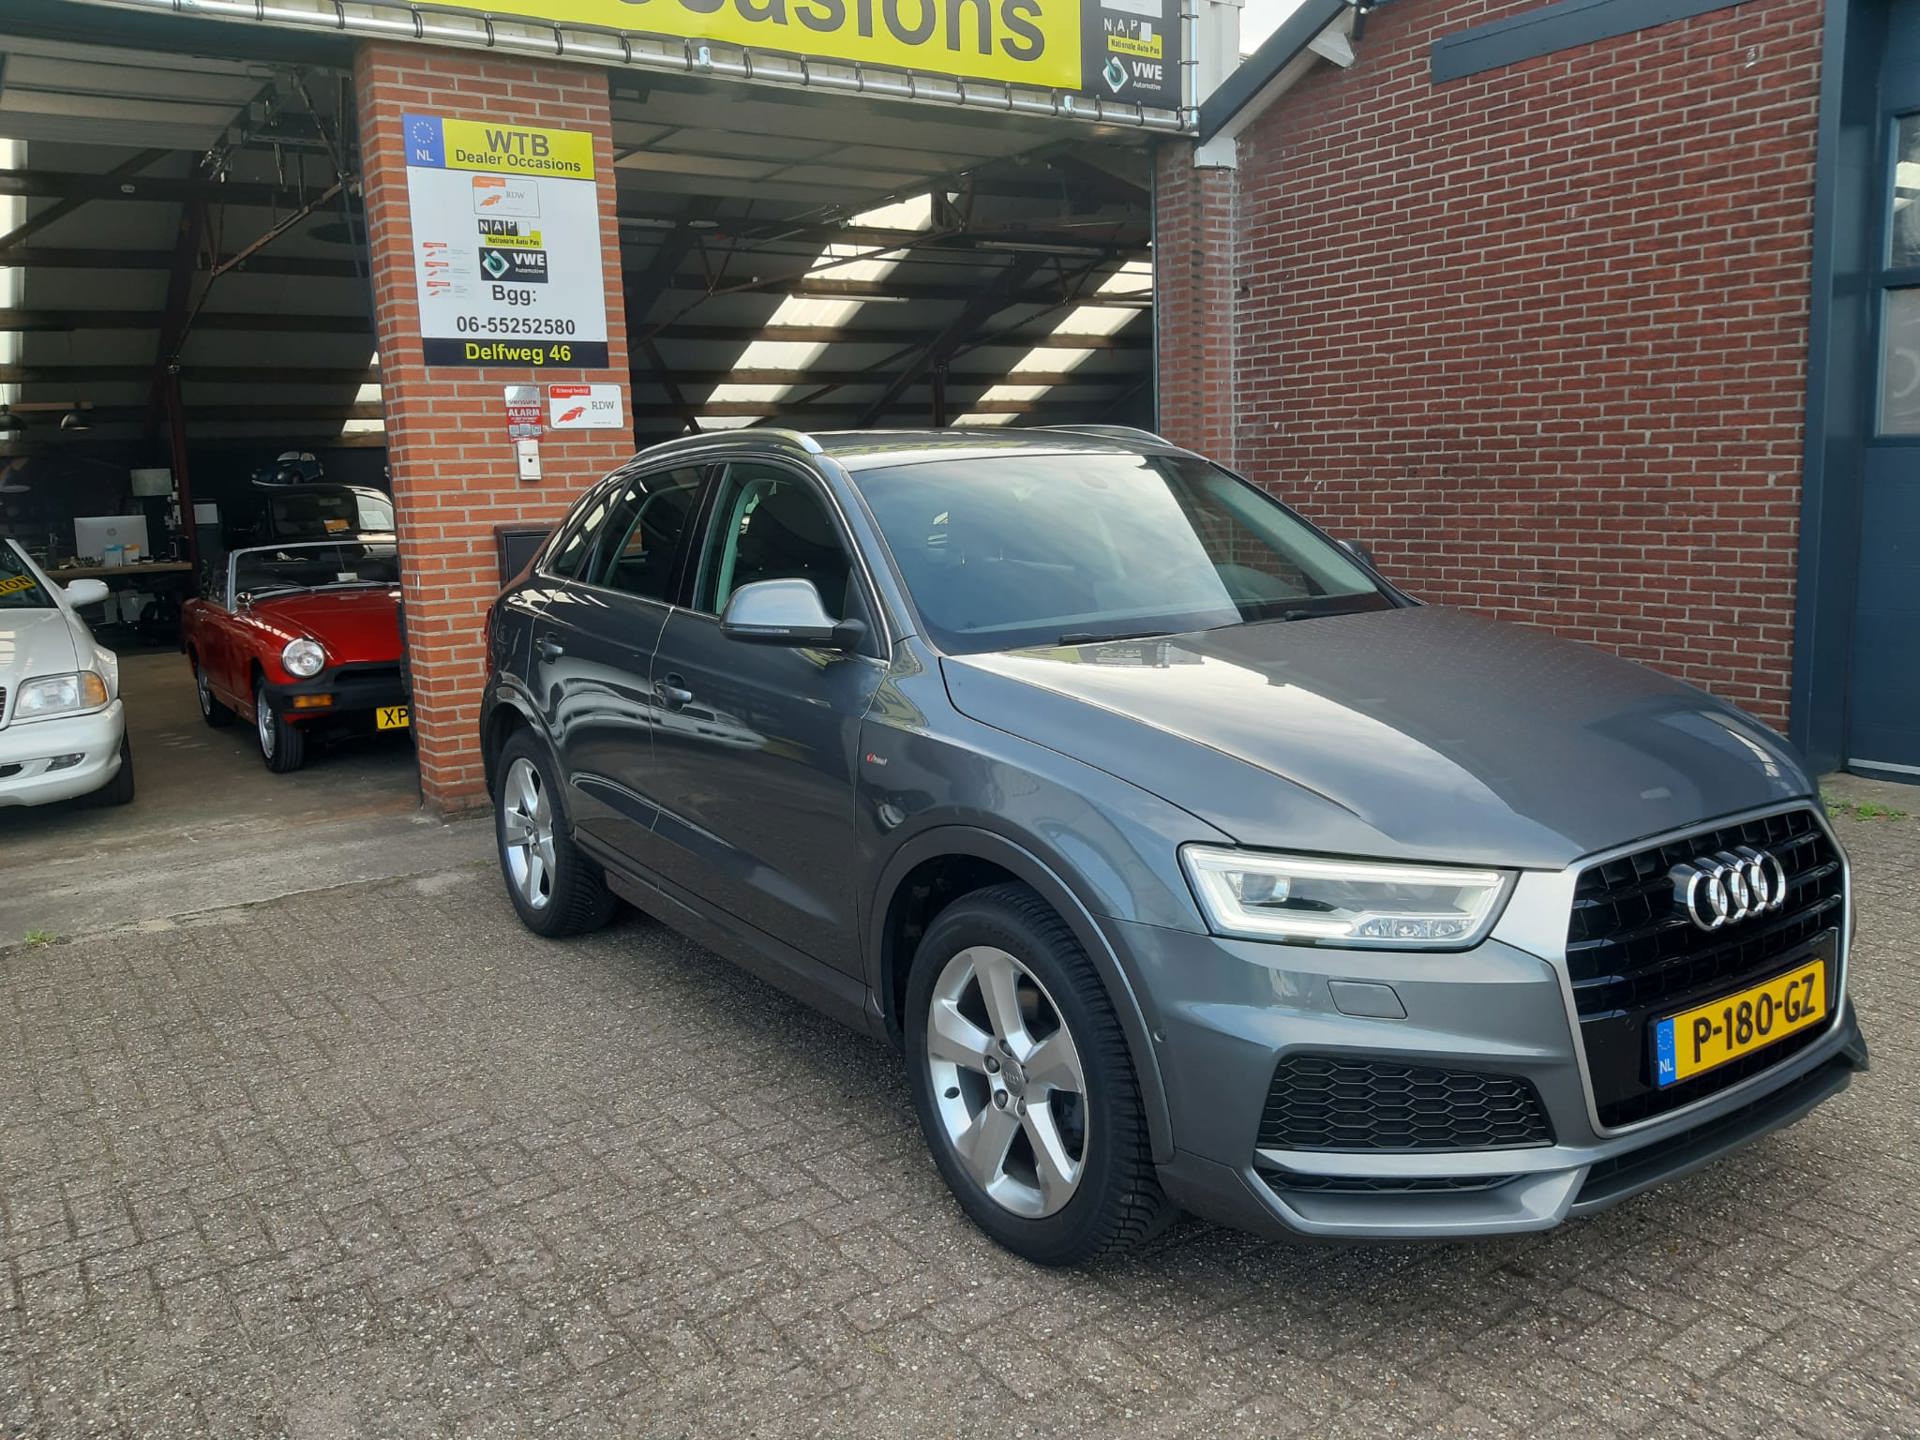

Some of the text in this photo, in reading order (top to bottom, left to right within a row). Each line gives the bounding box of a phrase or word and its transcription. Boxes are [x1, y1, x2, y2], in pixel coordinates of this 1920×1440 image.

[1112, 39, 1160, 54] Nationale Auto Pas
[1132, 61, 1163, 80] VWE
[1133, 81, 1161, 90] Automotive
[485, 128, 549, 157] WTB
[416, 149, 434, 161] NL
[456, 149, 581, 172] Dealer Occasions
[506, 191, 525, 199] RDW
[488, 237, 514, 245] Nationale
[513, 252, 545, 266] VWE
[492, 285, 537, 306] Bgg:
[457, 316, 575, 335] 06-55252580
[465, 343, 571, 365] Delfweg 46
[508, 409, 540, 417] ALARM
[591, 401, 615, 410] RDW
[0, 576, 32, 592] ION
[1693, 973, 1816, 1063] P-180-GZ
[1659, 1060, 1674, 1075] NL
